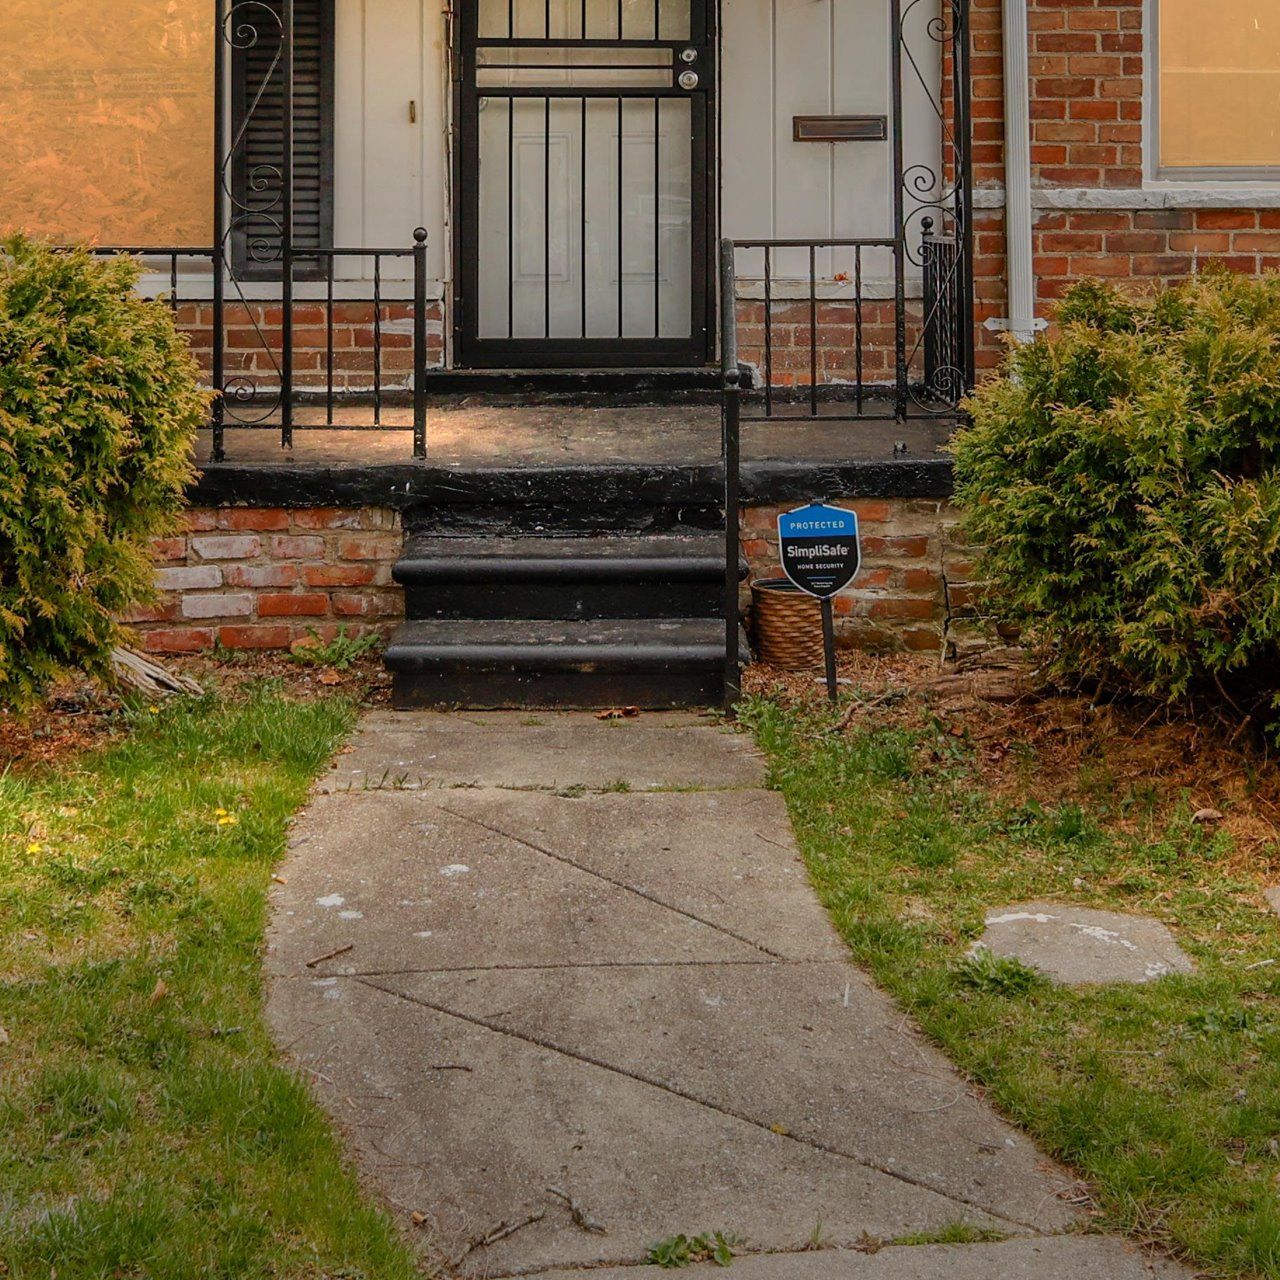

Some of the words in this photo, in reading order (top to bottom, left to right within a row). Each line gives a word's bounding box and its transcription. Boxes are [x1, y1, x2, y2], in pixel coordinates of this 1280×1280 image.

[790, 520, 845, 530] PROTECTED
[787, 544, 848, 559] SimpliSafe
[815, 562, 844, 570] SECURITY
